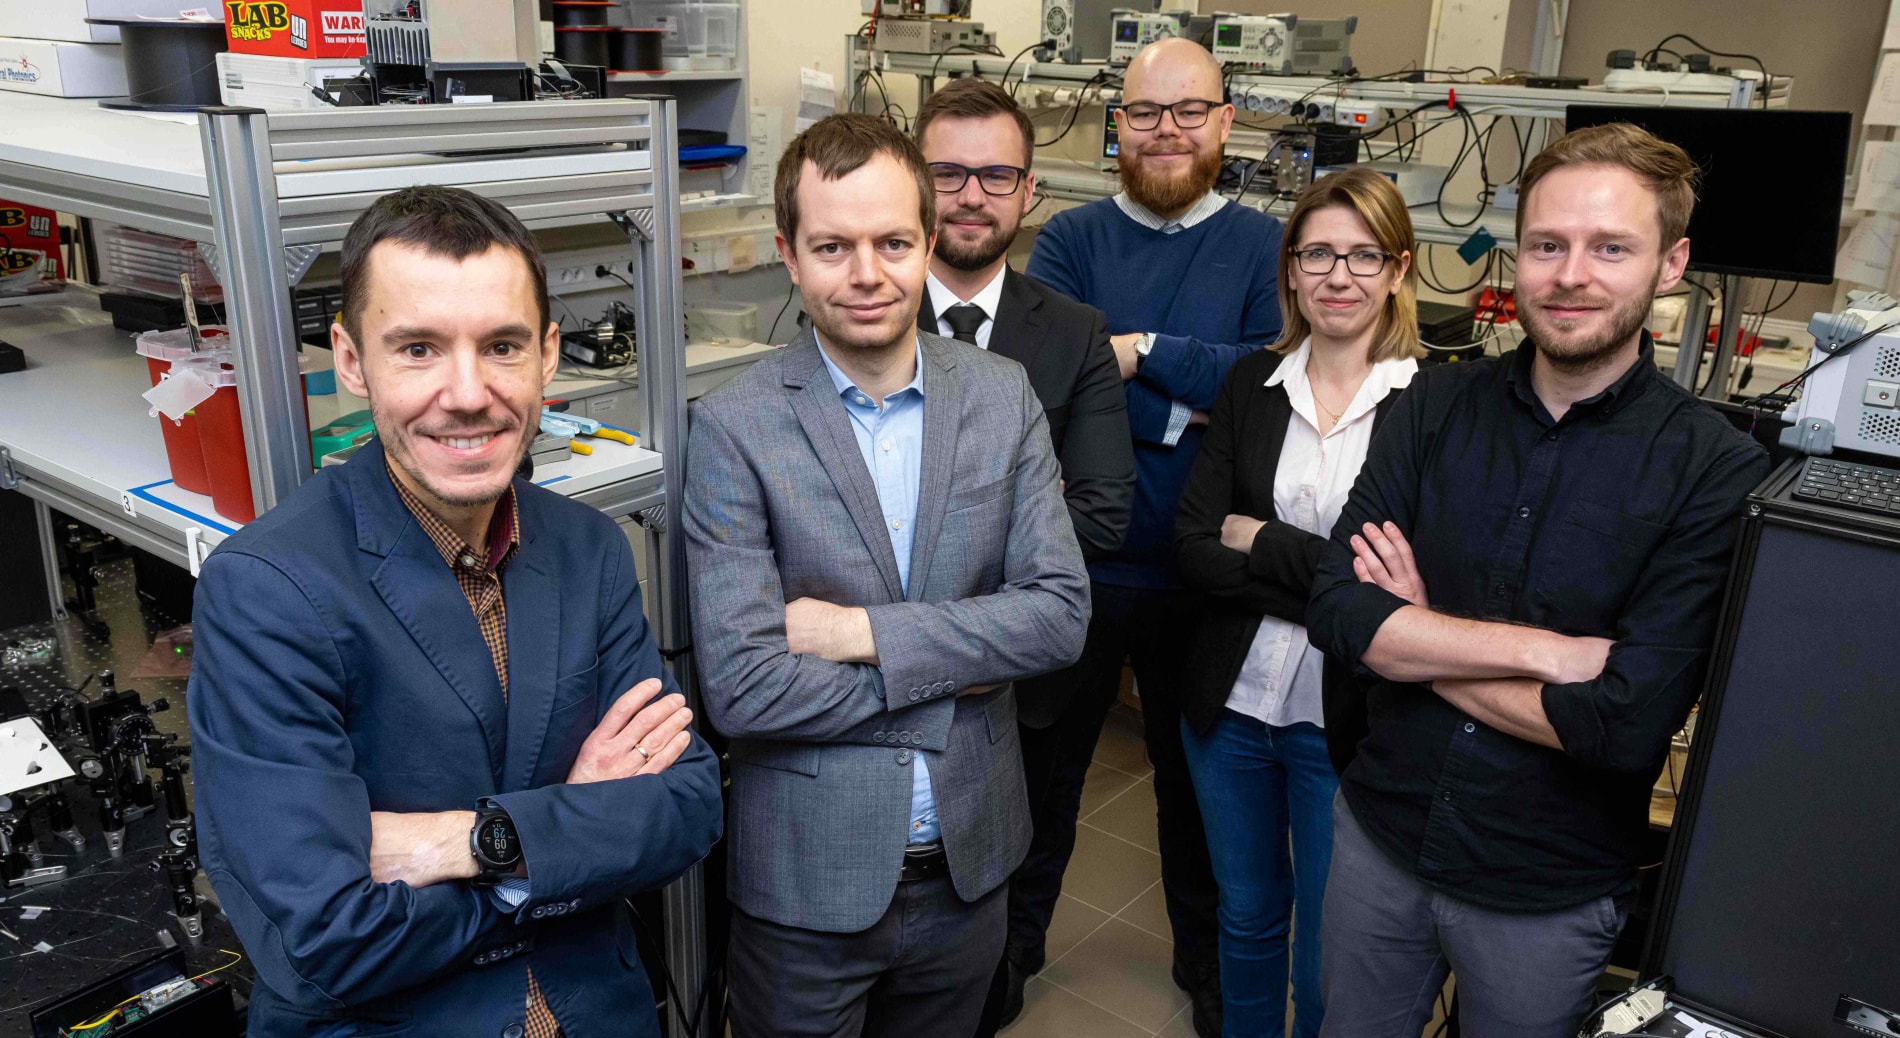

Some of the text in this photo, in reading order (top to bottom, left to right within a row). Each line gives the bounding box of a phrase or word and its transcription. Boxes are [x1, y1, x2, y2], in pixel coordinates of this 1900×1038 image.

[227, 2, 289, 30] LAB
[231, 26, 271, 40] SNACKS
[123, 495, 131, 512] 3
